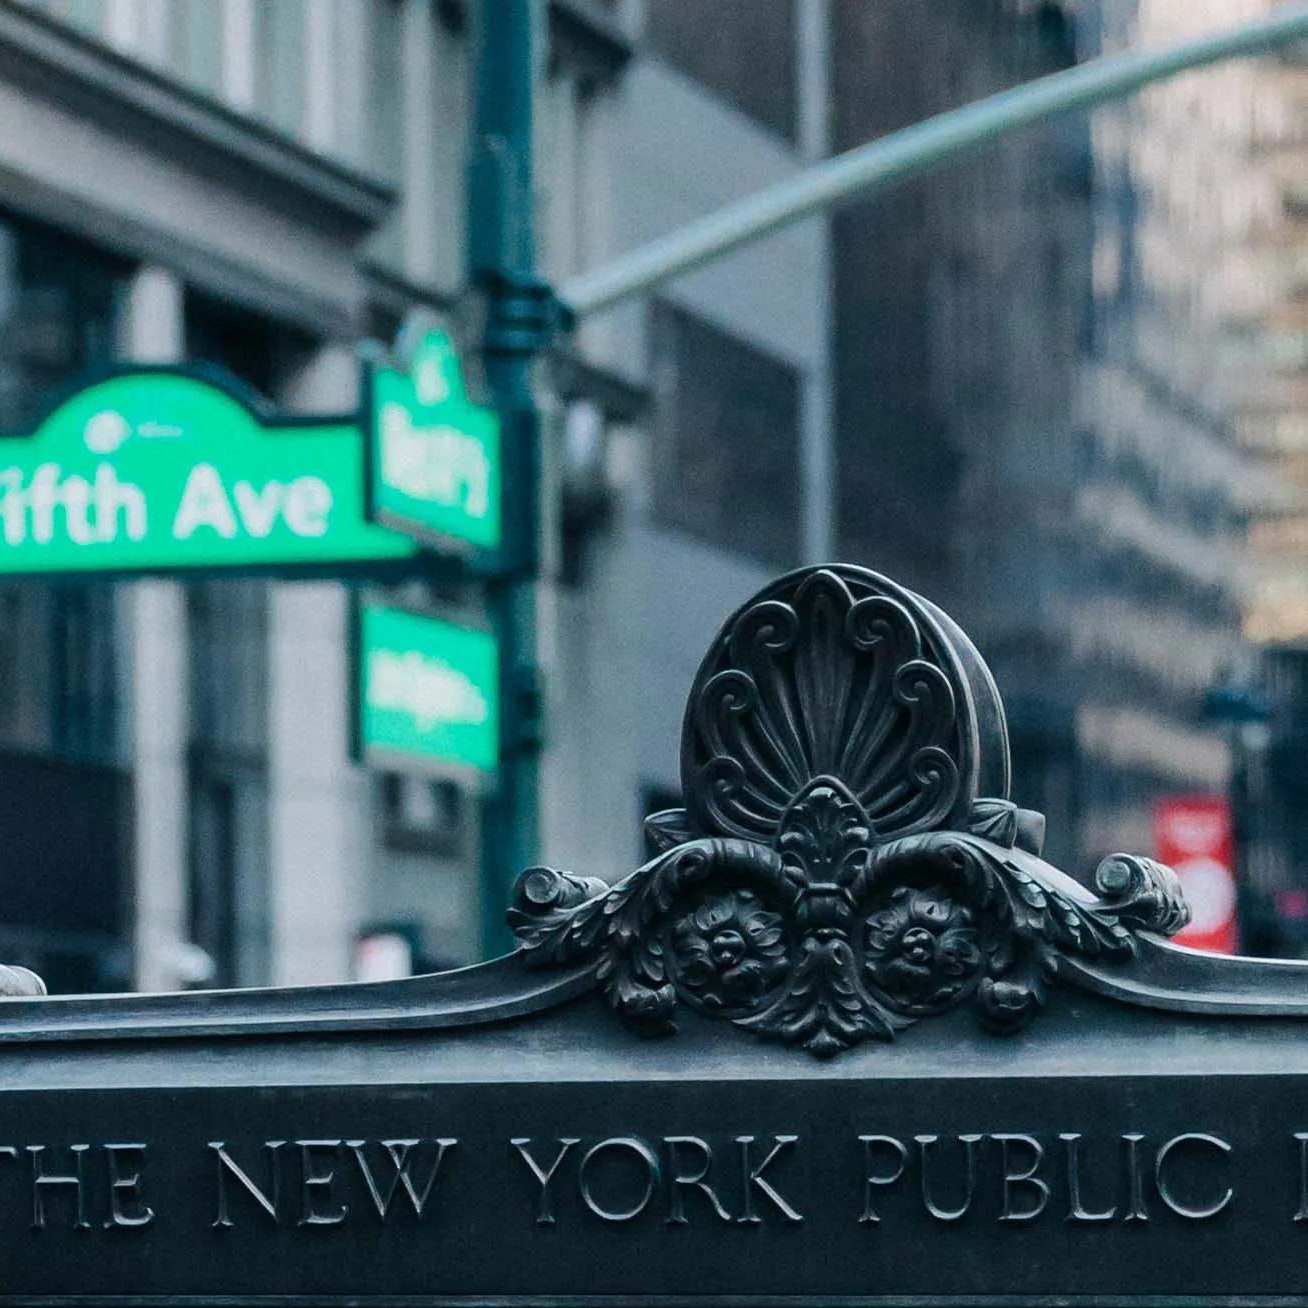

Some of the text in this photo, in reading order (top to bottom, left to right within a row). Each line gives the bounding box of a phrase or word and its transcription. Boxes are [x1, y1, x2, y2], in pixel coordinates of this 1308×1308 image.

[173, 463, 334, 540] Ave
[207, 1137, 459, 1227] NEW
[510, 1134, 803, 1223] YORK
[857, 1131, 1234, 1222] PUBLIC
